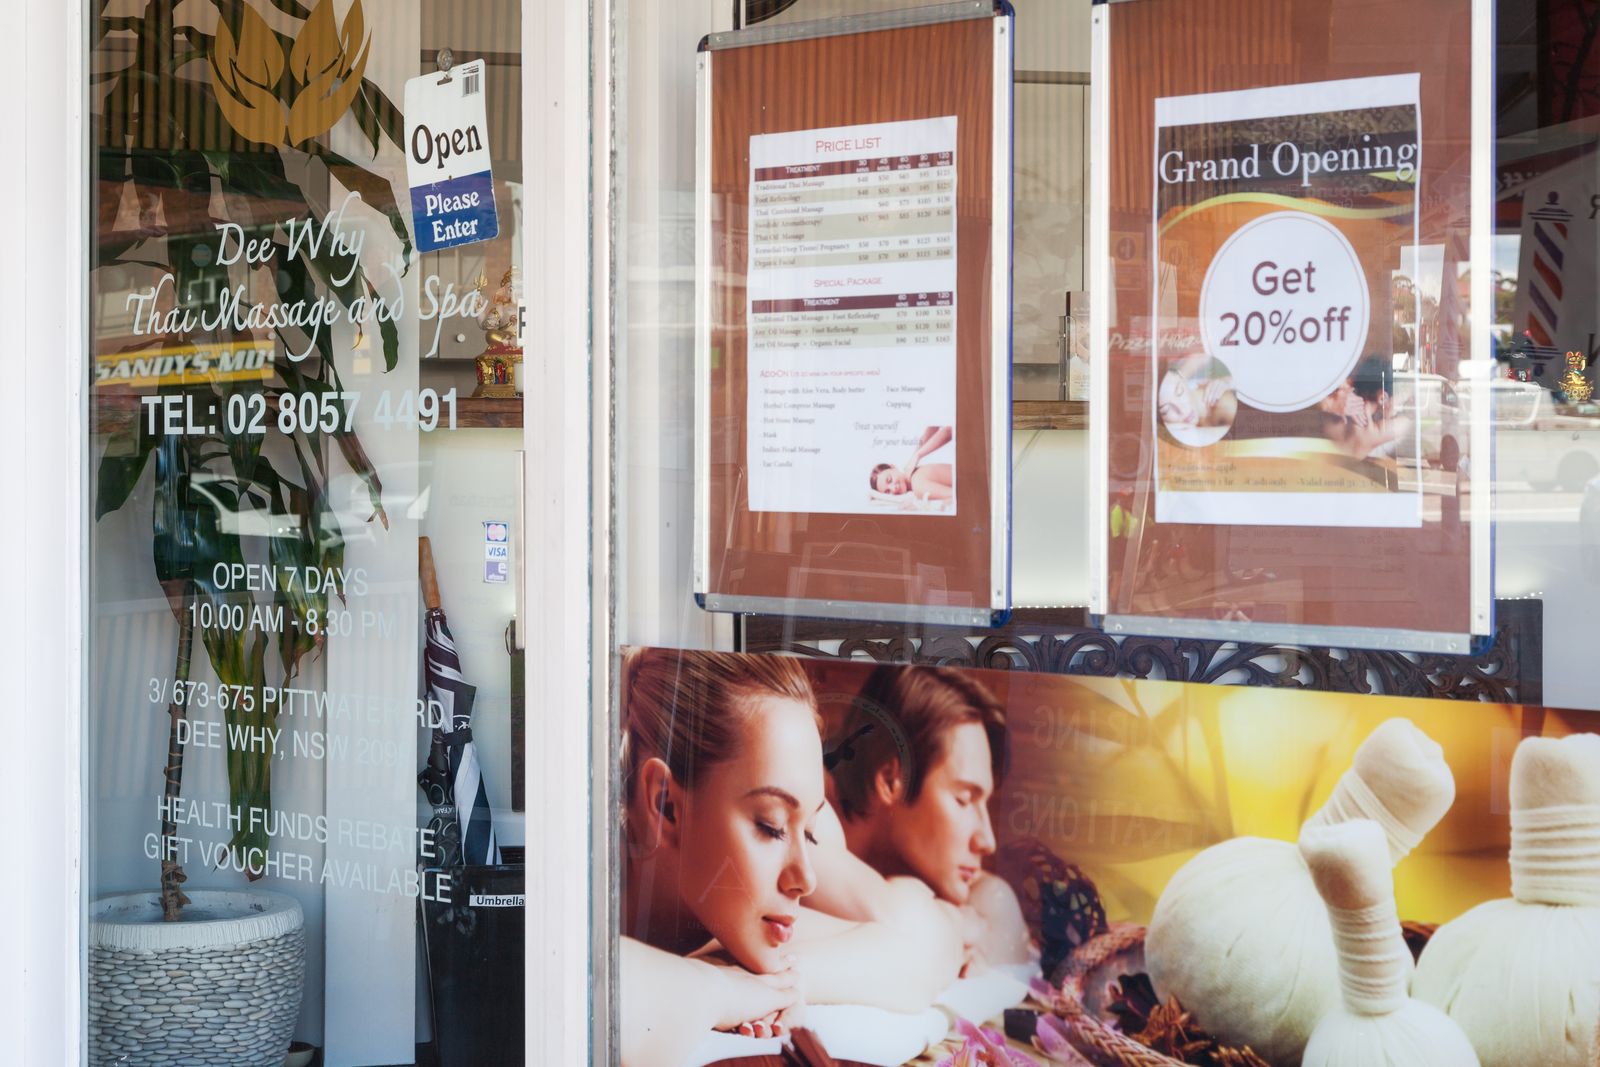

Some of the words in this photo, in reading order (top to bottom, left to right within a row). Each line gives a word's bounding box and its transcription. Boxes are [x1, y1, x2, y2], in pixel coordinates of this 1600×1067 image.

[411, 124, 482, 169] Open
[815, 139, 852, 153] PRICE
[855, 137, 882, 150] LIST
[1159, 144, 1260, 184] Grand
[1271, 134, 1418, 187] Opening
[425, 190, 480, 217] Please
[215, 221, 276, 266] Dee
[285, 190, 365, 288] Why
[432, 218, 478, 243] Enter
[814, 278, 845, 288] SPECIAL
[1252, 260, 1316, 296] Get
[125, 273, 200, 335] Thai
[200, 284, 342, 362] Massage
[348, 262, 404, 323] and
[417, 274, 488, 358] Spa
[1219, 306, 1352, 347] 20%off
[141, 394, 216, 436] TEL:
[226, 393, 267, 435] 02
[277, 391, 362, 434] 8057
[372, 387, 458, 432] 4491
[488, 547, 507, 557] VISA
[212, 562, 277, 592] OPEN
[286, 565, 297, 593] 7
[305, 566, 369, 597] DAYS
[189, 602, 244, 631] 10.00
[249, 604, 284, 633] AM
[305, 608, 352, 637] 8.30
[360, 610, 397, 640] PM
[172, 680, 255, 713] 673-675
[414, 698, 444, 729] RD
[176, 718, 221, 749] DEE
[228, 723, 285, 761] WHY,
[294, 730, 347, 761] NSW
[157, 795, 242, 832] HEALTH
[250, 806, 329, 844] FUNDS
[337, 820, 436, 859] REBATE
[144, 832, 193, 864] GIFT
[198, 840, 313, 883] VOUCHER
[320, 858, 452, 904] AVAILABLE
[476, 894, 525, 907] Umbrella
